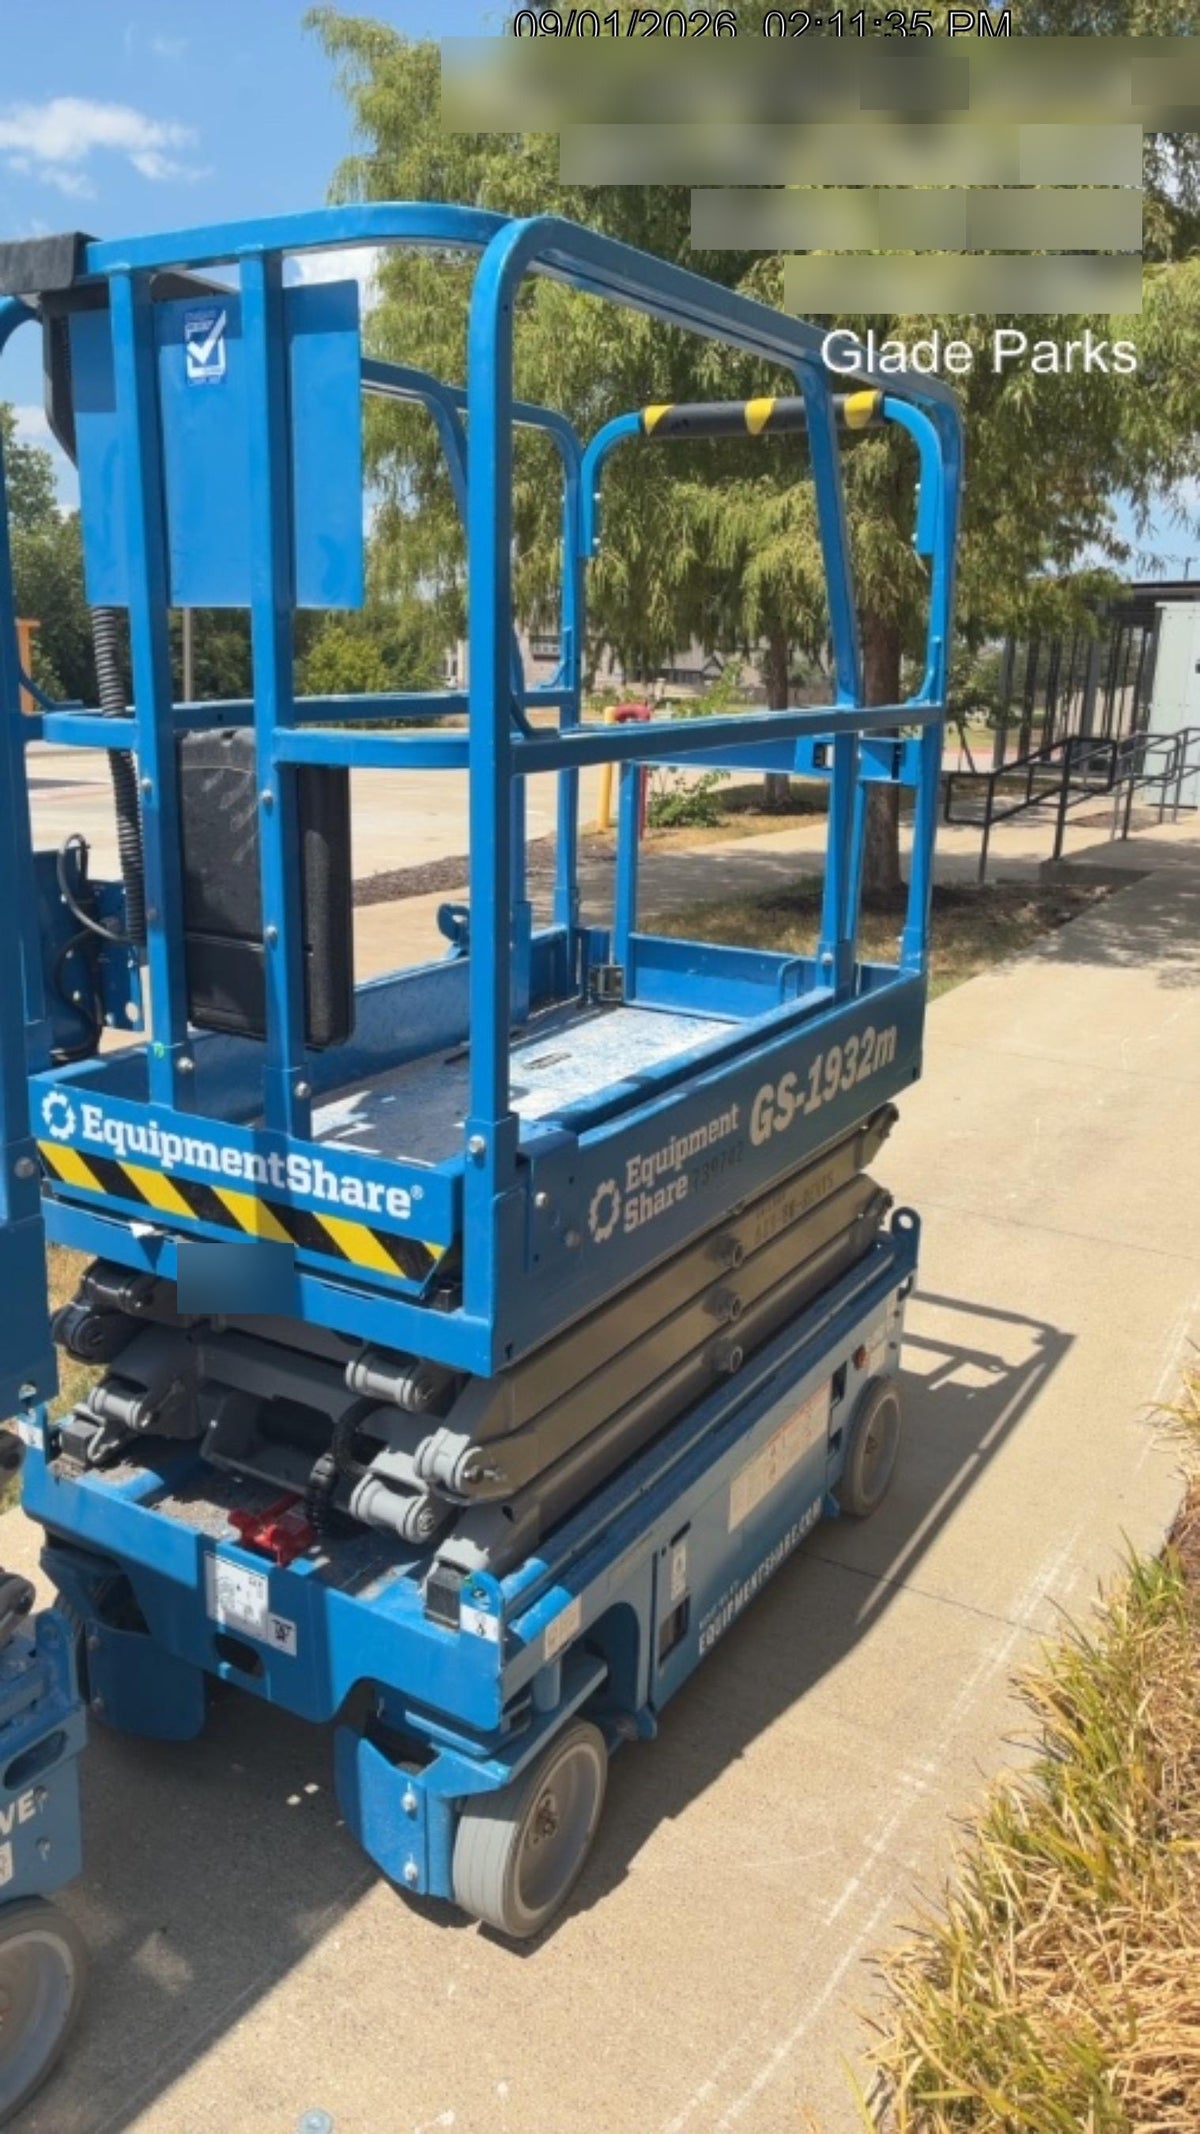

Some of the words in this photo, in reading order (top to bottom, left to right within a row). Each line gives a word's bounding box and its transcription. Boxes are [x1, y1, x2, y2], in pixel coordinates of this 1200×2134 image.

[751, 1026, 897, 1146] GS-1932m
[625, 1102, 739, 1193] Equipment
[623, 1174, 689, 1234] Share
